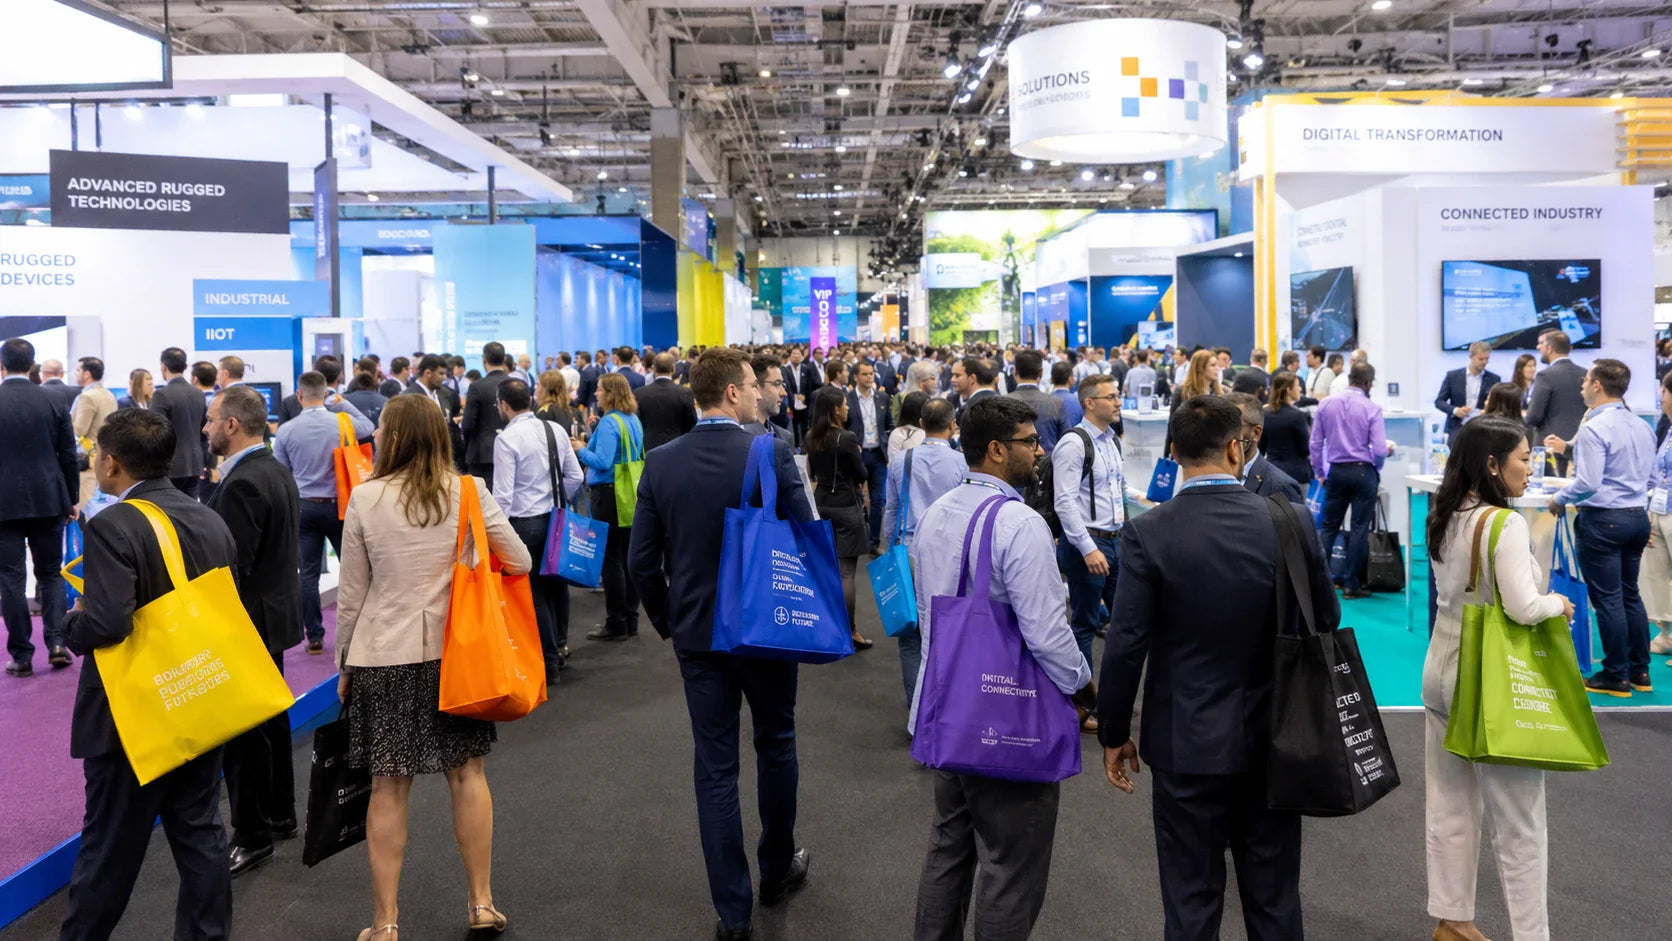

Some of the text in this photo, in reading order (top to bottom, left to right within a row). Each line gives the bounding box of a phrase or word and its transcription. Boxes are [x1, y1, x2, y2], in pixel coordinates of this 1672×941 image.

[1018, 70, 1090, 96] SOLUTIONS
[1303, 128, 1504, 142] DIGITAL TRANSFORMATION
[67, 177, 226, 197] ADVANCED RUGGED
[68, 195, 191, 213] TECHNOLOGIES
[1440, 207, 1603, 220] CONNECTED INDUSTRY
[1, 253, 76, 267] RUGGED
[1, 273, 75, 286] DEVICES
[205, 292, 290, 306] INDUSTRIAL
[813, 289, 832, 300] VIP
[205, 328, 235, 341] IIOT
